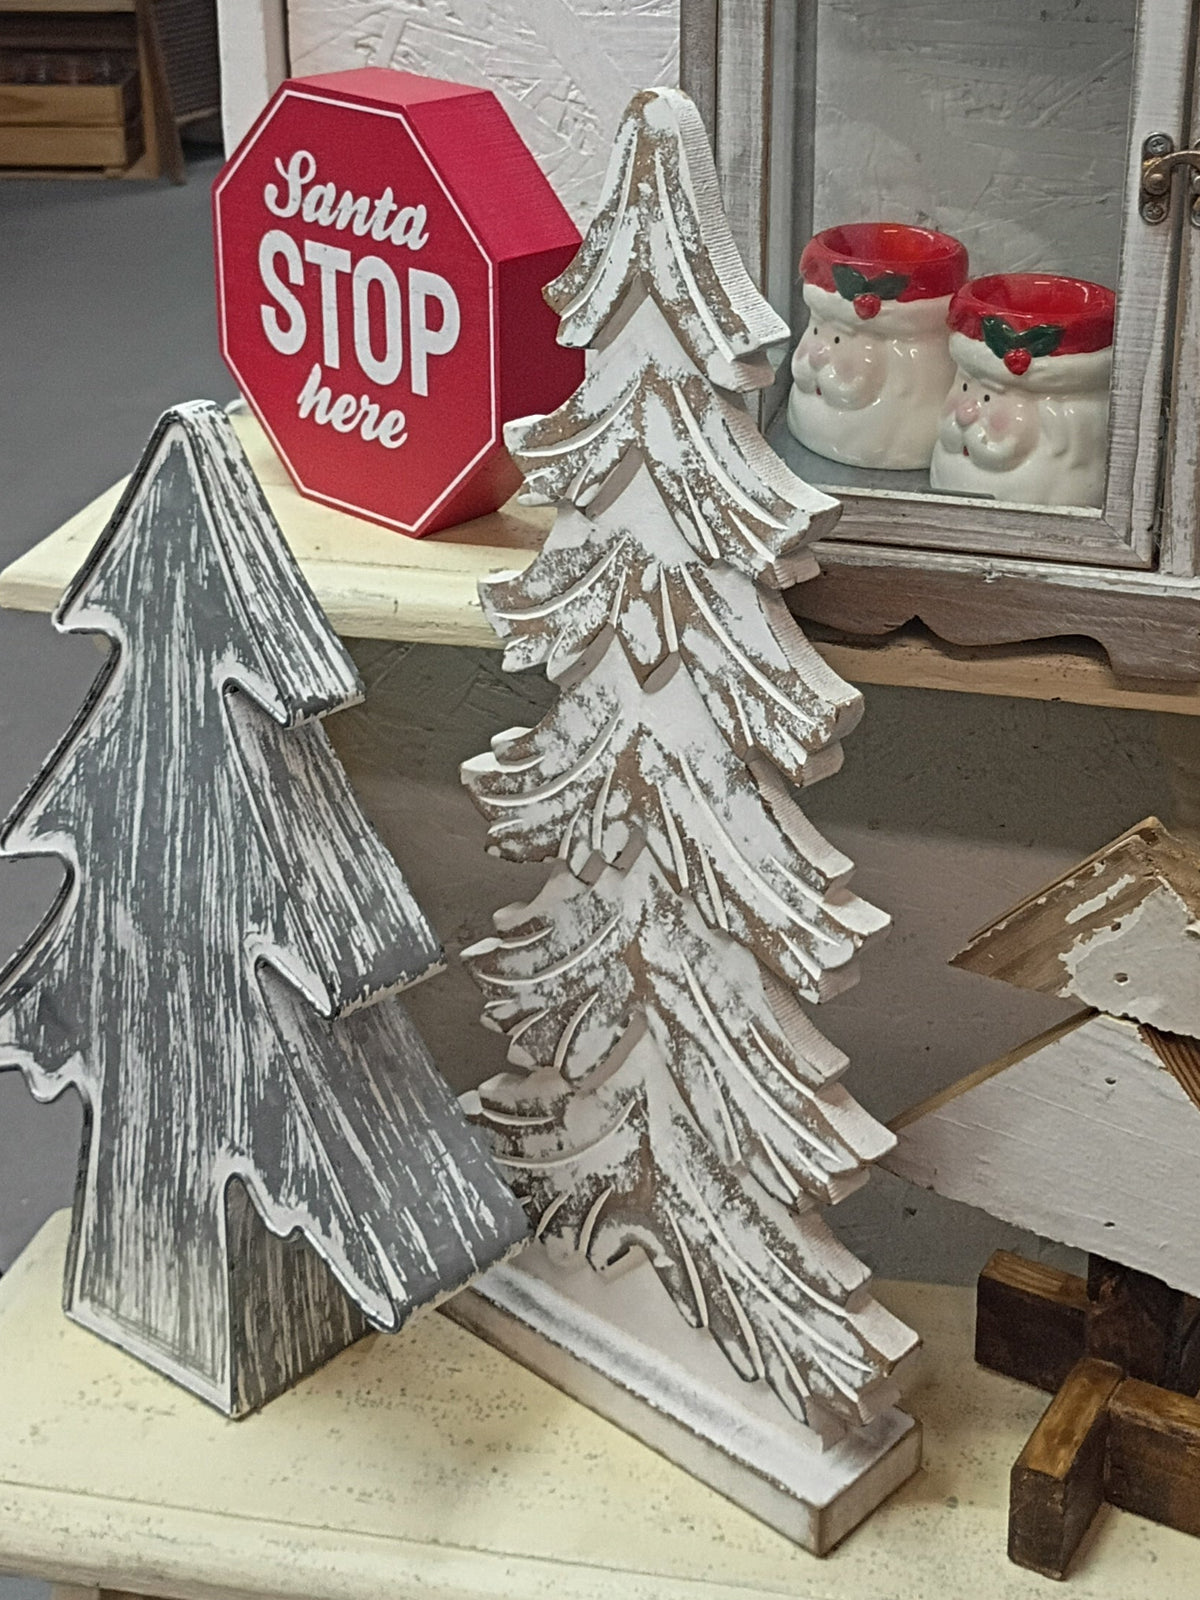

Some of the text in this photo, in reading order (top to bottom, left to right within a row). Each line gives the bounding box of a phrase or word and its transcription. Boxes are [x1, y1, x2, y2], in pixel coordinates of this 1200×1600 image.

[263, 150, 430, 251] Santa
[258, 229, 461, 397] STOP
[296, 362, 408, 449] here
